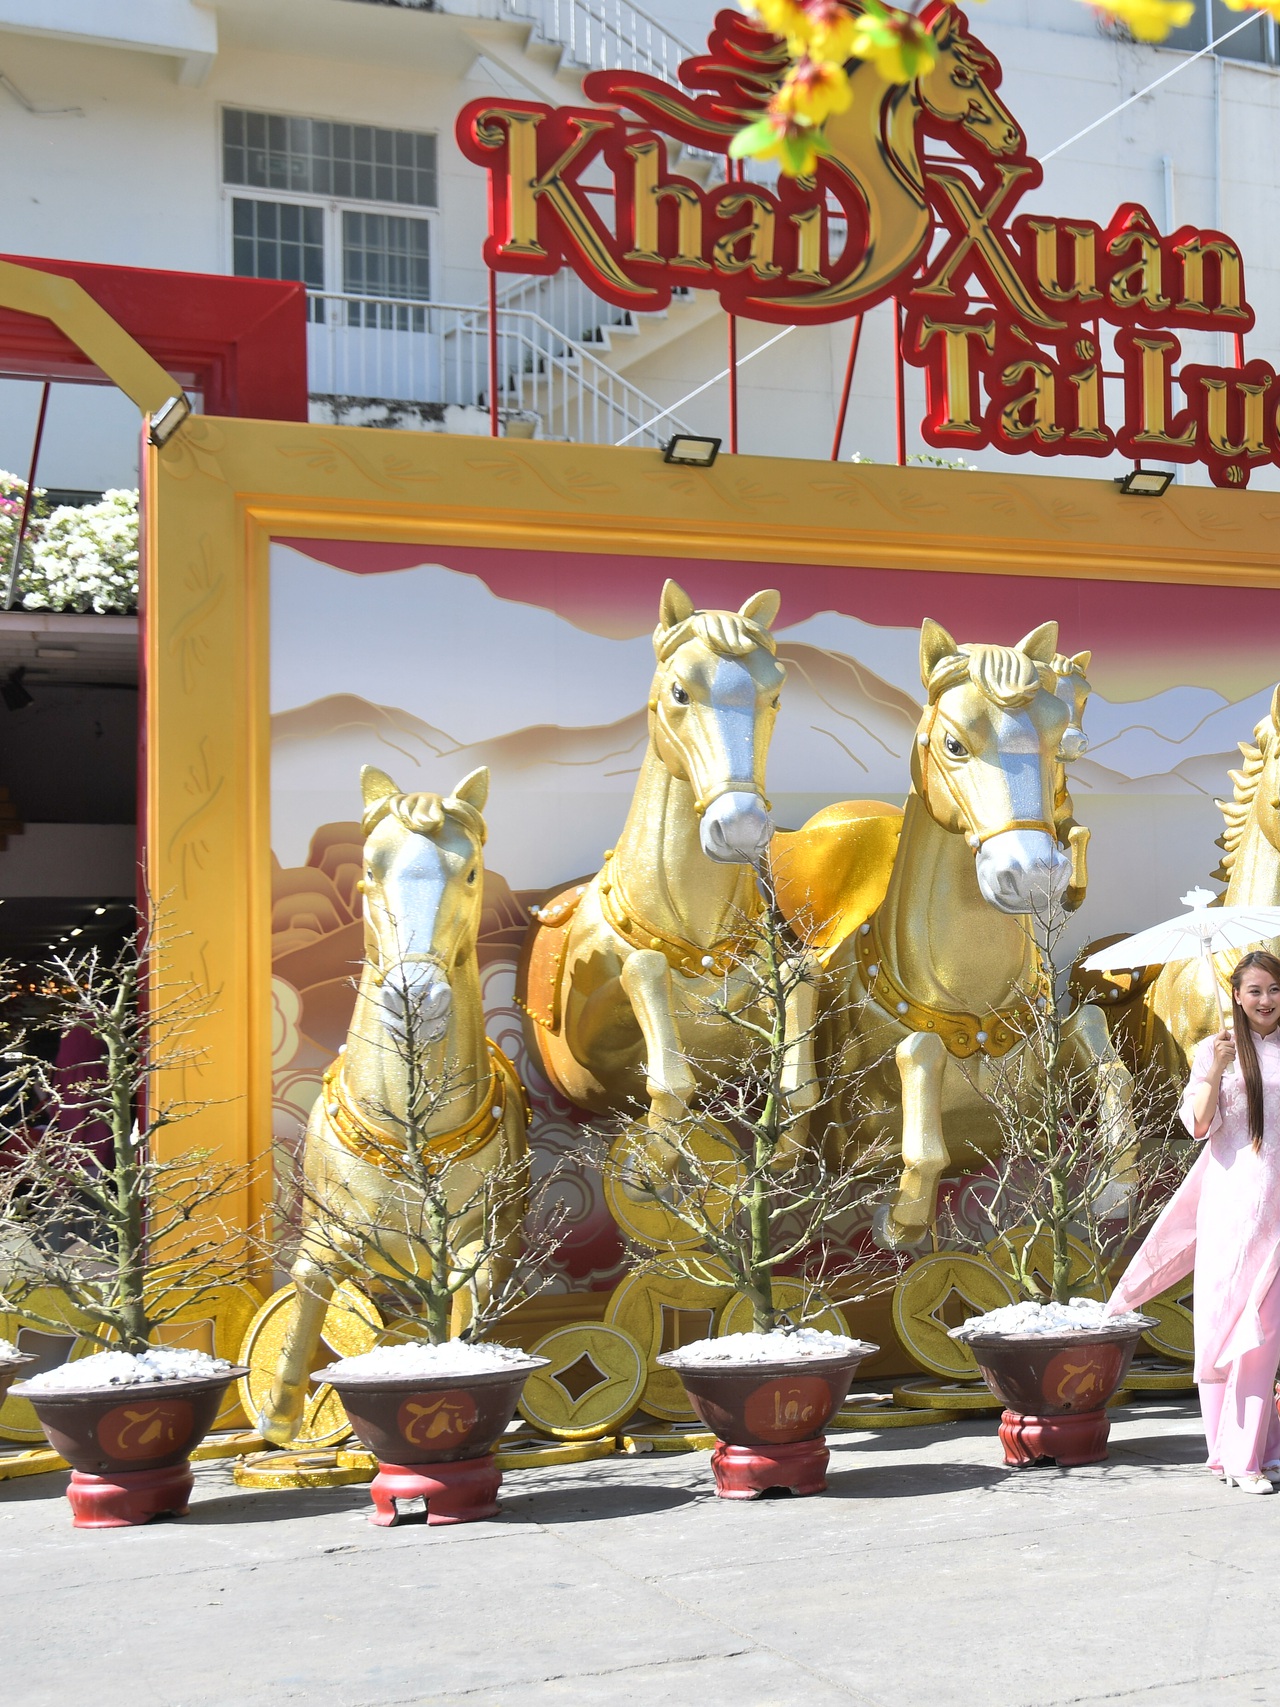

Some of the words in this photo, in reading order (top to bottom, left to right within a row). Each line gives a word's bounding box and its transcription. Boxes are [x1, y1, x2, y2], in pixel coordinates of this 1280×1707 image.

[474, 107, 831, 295] Khai
[911, 162, 1249, 330] Xuân
[918, 313, 1109, 443] Tài
